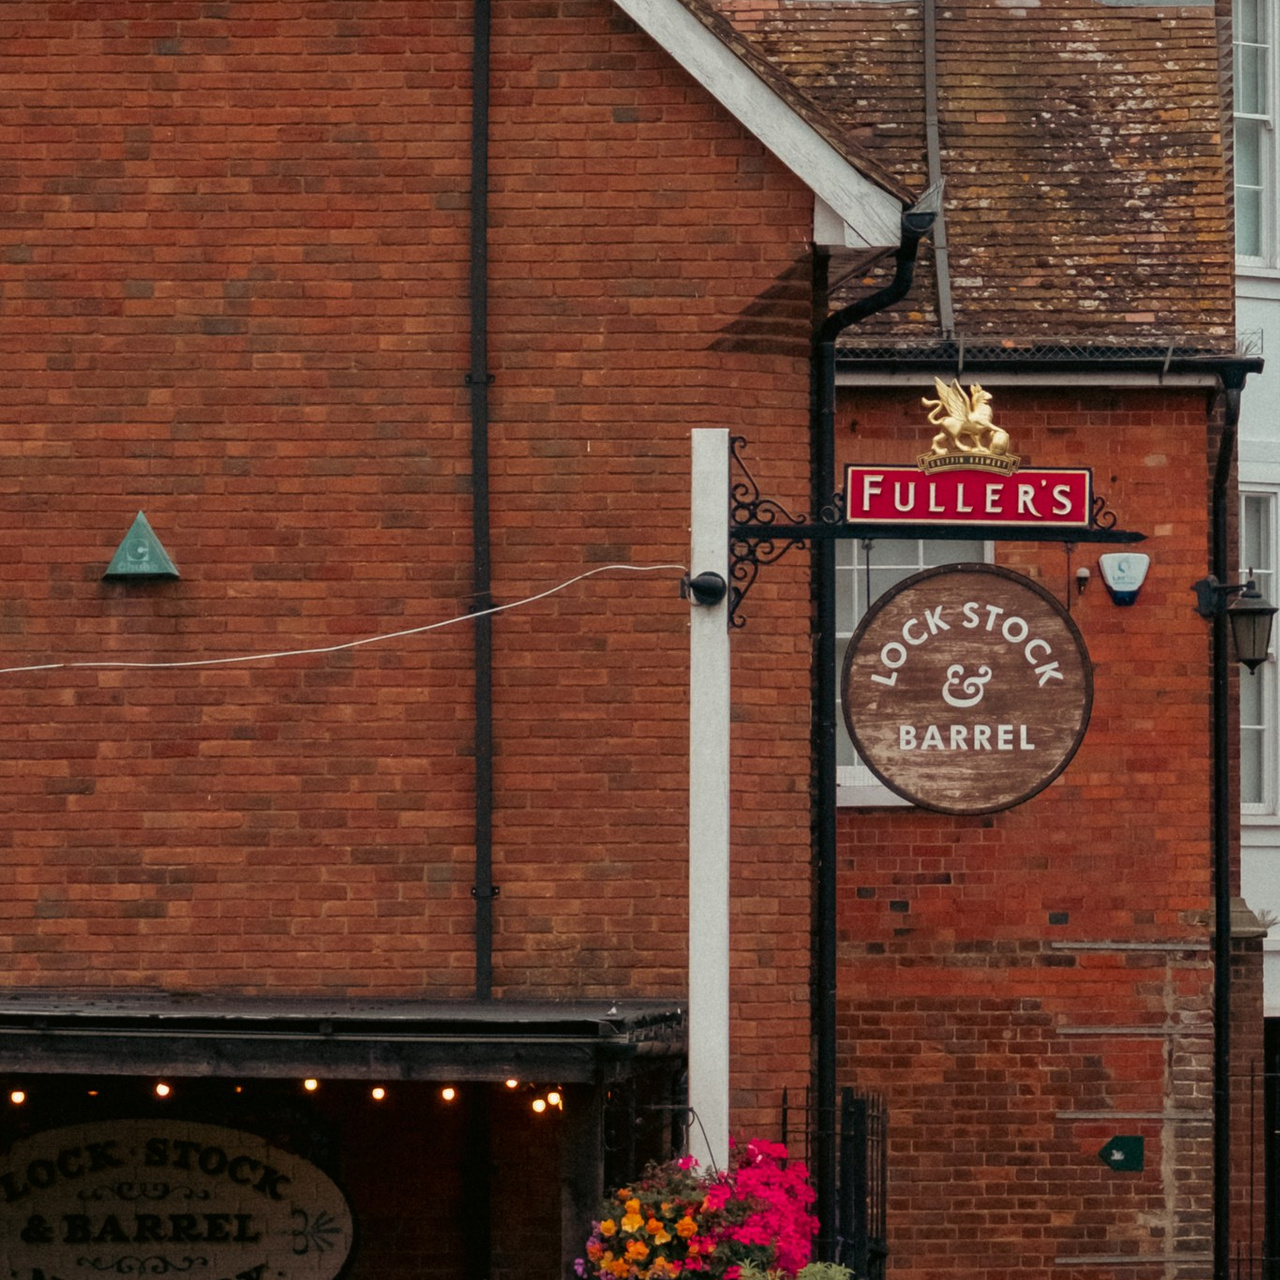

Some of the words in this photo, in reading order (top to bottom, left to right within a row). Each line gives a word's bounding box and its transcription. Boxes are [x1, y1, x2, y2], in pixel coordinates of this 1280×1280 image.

[862, 474, 1073, 518] FULLER'S
[871, 605, 951, 687] LOCK
[961, 601, 1064, 687] STOCK
[942, 664, 992, 708] &
[899, 724, 1036, 752] BARREL
[0, 1139, 124, 1203] LOCK
[144, 1137, 291, 1200] STOCK
[20, 1213, 54, 1244] &
[61, 1213, 264, 1244] BARREL
